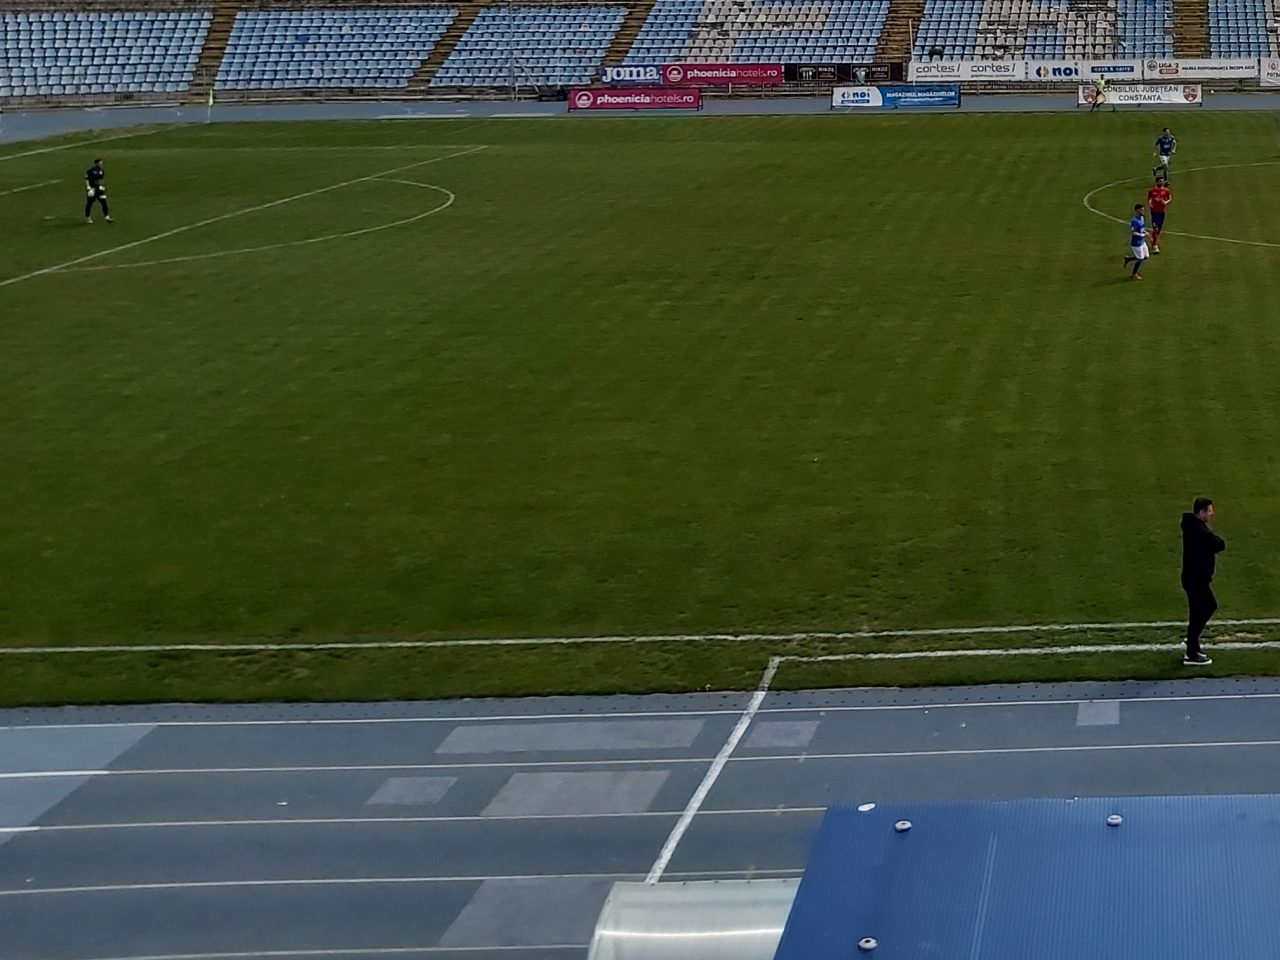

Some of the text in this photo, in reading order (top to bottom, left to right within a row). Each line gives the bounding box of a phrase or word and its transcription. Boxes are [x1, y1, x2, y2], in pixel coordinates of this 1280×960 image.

[687, 64, 777, 79] phoeniciahotels.ro
[1052, 62, 1079, 77] noi
[597, 93, 694, 105] phoeniciahotels.ro
[853, 88, 870, 98] noi
